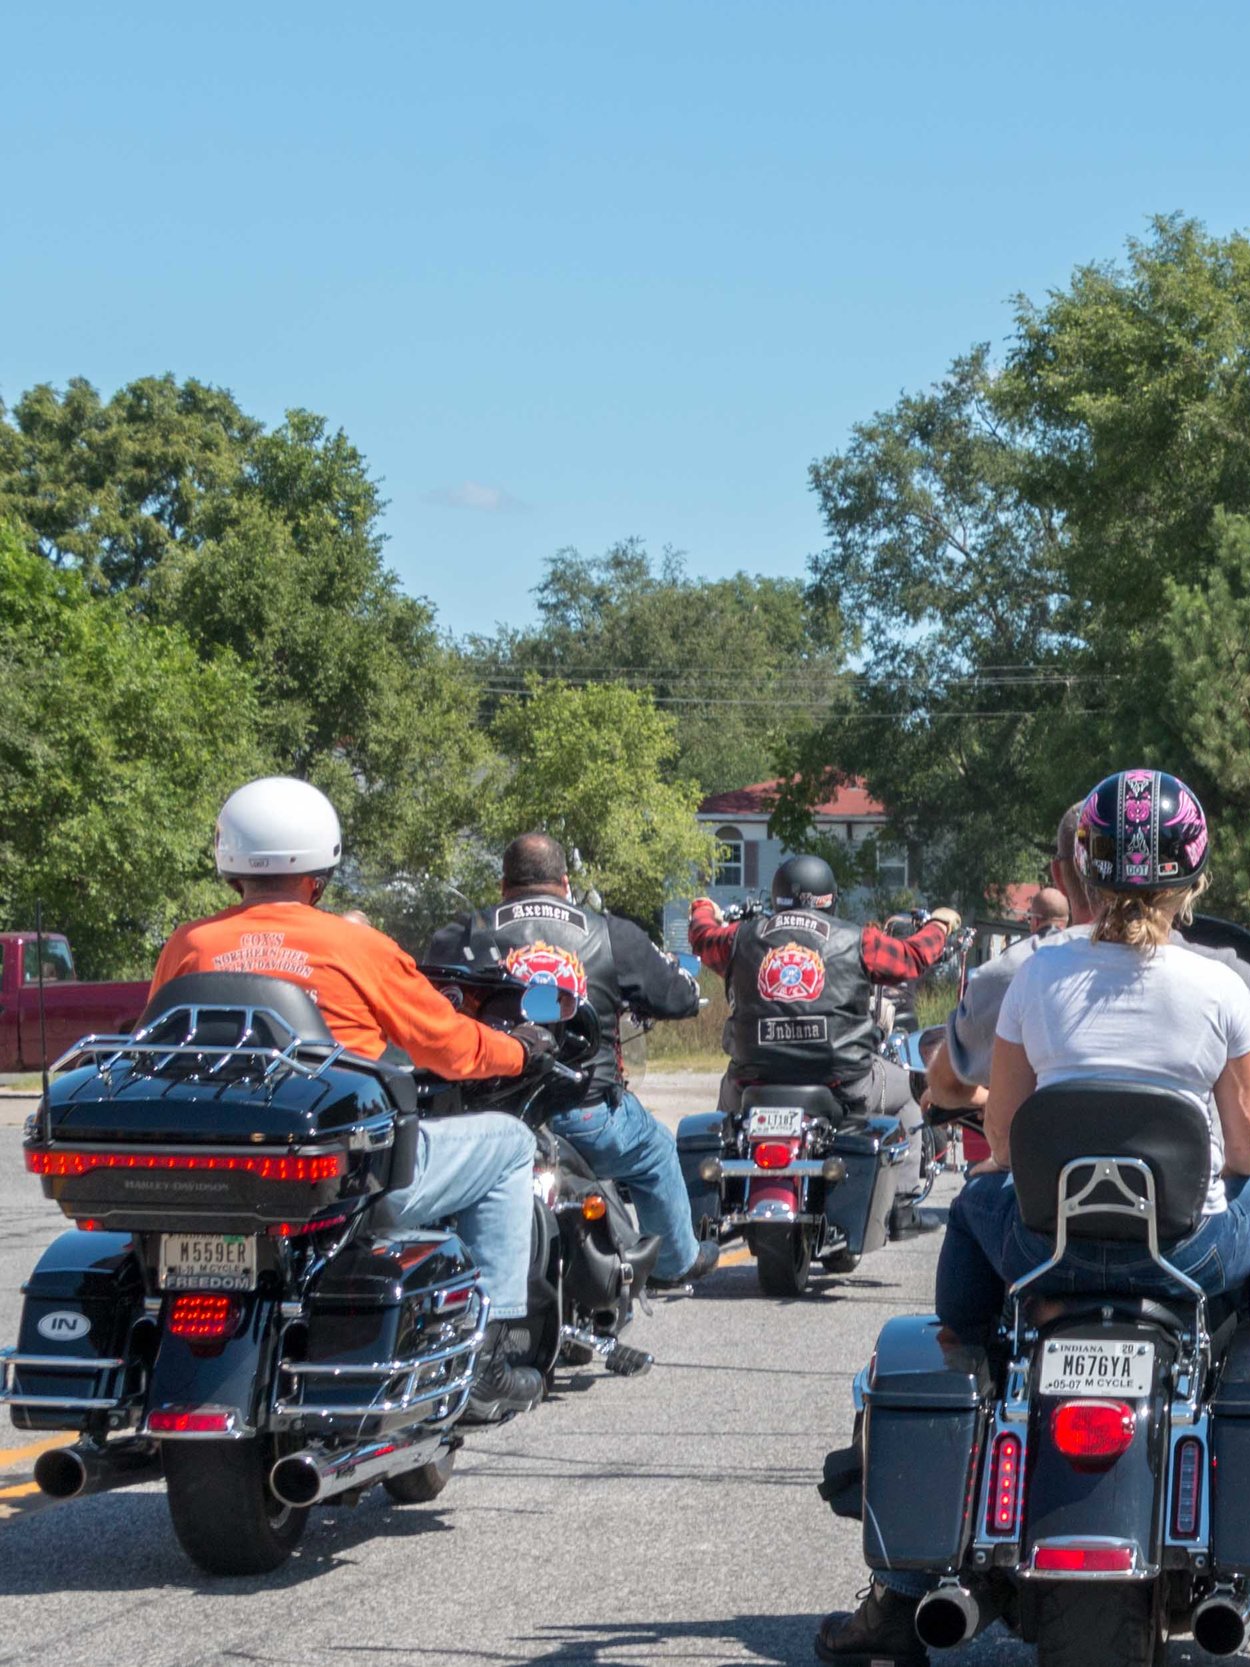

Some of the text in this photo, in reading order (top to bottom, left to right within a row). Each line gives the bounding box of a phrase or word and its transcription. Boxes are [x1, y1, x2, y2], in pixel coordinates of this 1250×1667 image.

[512, 904, 570, 921] Axemen
[775, 914, 818, 931] Axemen
[240, 931, 285, 947] COX'S
[764, 1020, 820, 1040] Indiana
[180, 1241, 246, 1263] M559ER
[166, 1276, 250, 1290] FREEDOM
[51, 1317, 78, 1330] IN
[1060, 1343, 1104, 1353] INDIANA
[1062, 1354, 1131, 1378] M676YA
[1053, 1379, 1134, 1389] 05-07 M CYCLE
